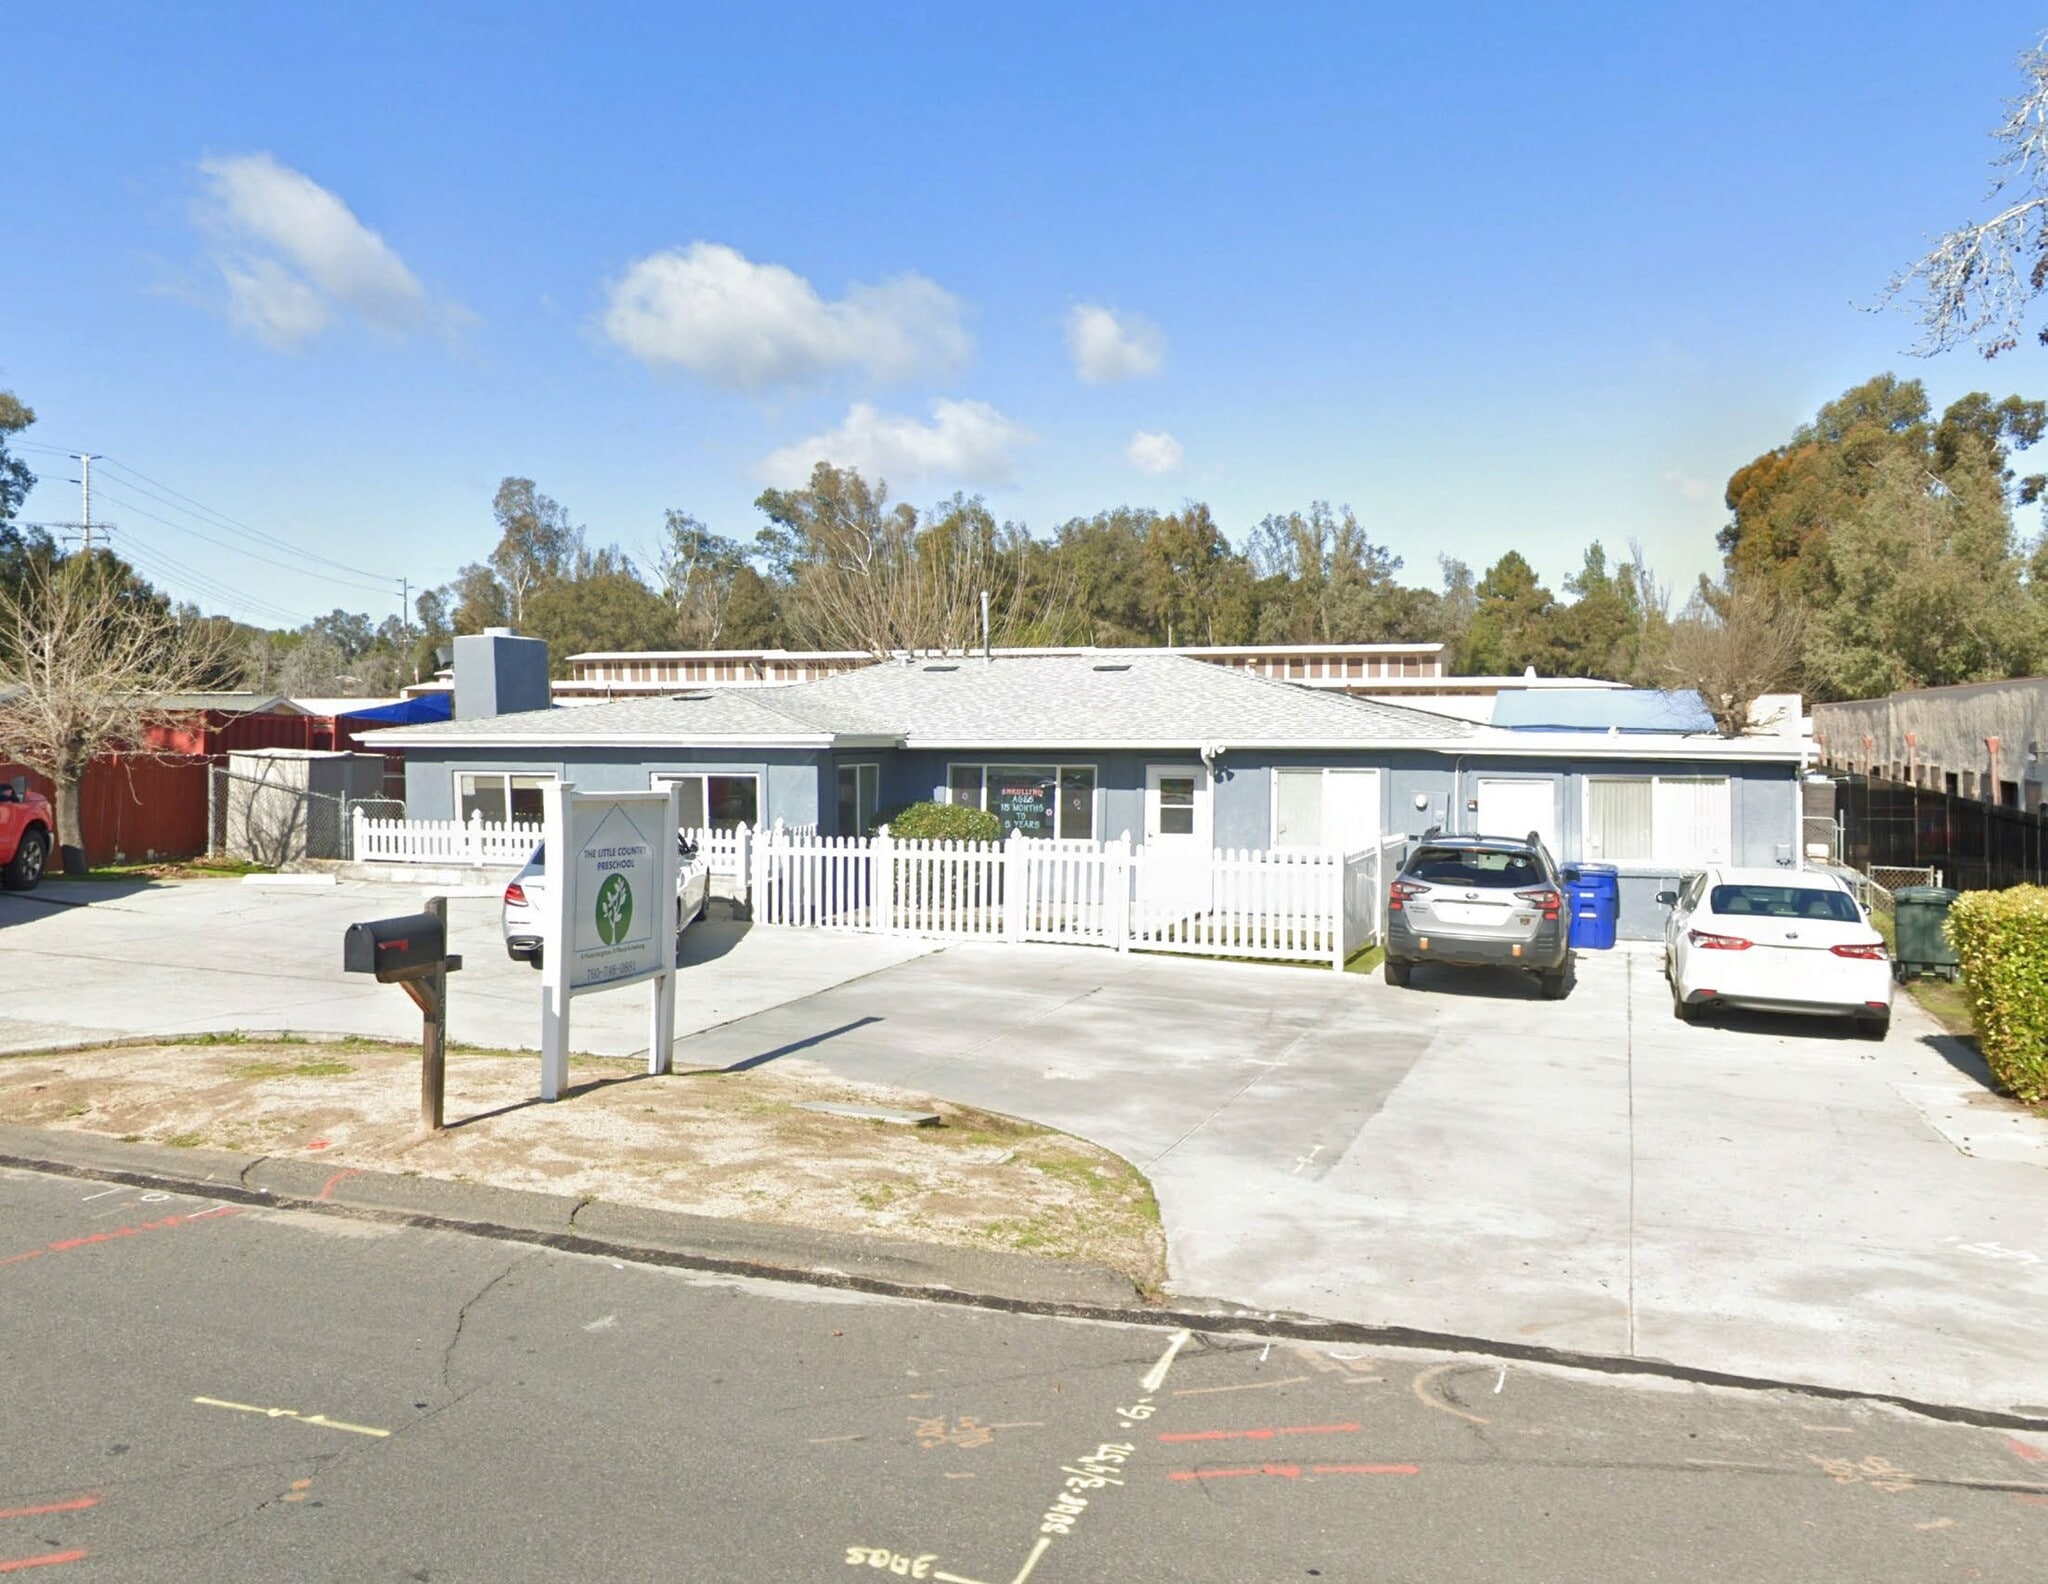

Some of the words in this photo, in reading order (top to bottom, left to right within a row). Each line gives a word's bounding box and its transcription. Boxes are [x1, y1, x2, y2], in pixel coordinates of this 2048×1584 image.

[1012, 795, 1034, 804] AGES
[1013, 803, 1044, 812] MONTHS
[1016, 812, 1026, 820] TO
[1014, 820, 1040, 829] YEARS
[584, 849, 597, 858] THE
[598, 848, 616, 858] LITTLE
[617, 846, 647, 856] COUNTRY
[597, 859, 635, 871] PRESCHOOL
